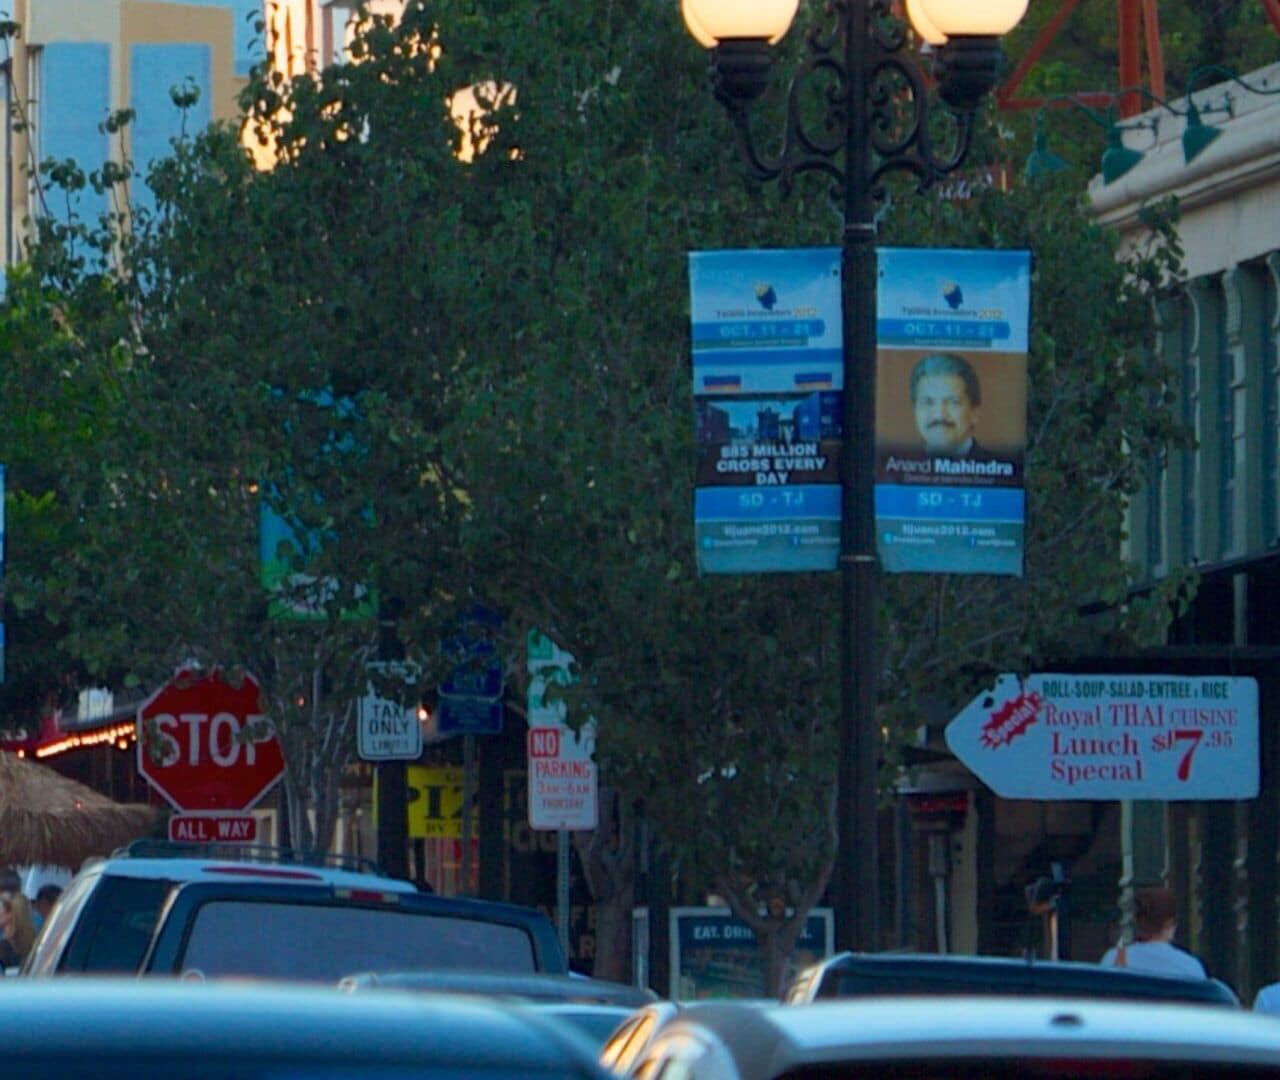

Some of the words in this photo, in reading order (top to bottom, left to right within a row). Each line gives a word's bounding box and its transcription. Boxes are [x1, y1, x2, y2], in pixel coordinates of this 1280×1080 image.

[752, 443, 818, 457] MILLION
[716, 458, 771, 472] CROSS
[773, 457, 827, 470] EVERY
[885, 456, 932, 473] Anand
[934, 458, 1015, 476] Mahindra
[755, 472, 789, 486] DAY
[739, 492, 764, 507] SD
[782, 491, 805, 506] TJ
[917, 492, 943, 507] SD
[959, 493, 983, 508] TJ
[1201, 681, 1229, 699] RICE
[1045, 703, 1103, 730] Royal
[1108, 703, 1164, 727] THAI
[1169, 708, 1238, 726] CUISINE
[368, 721, 410, 735] ONLY
[149, 712, 278, 767] STOP
[533, 731, 558, 755] NO
[1050, 731, 1139, 756] Lunch
[535, 762, 591, 778] PARKING
[1050, 758, 1143, 785] Special
[176, 821, 209, 839] ALL
[217, 820, 251, 839] WAY
